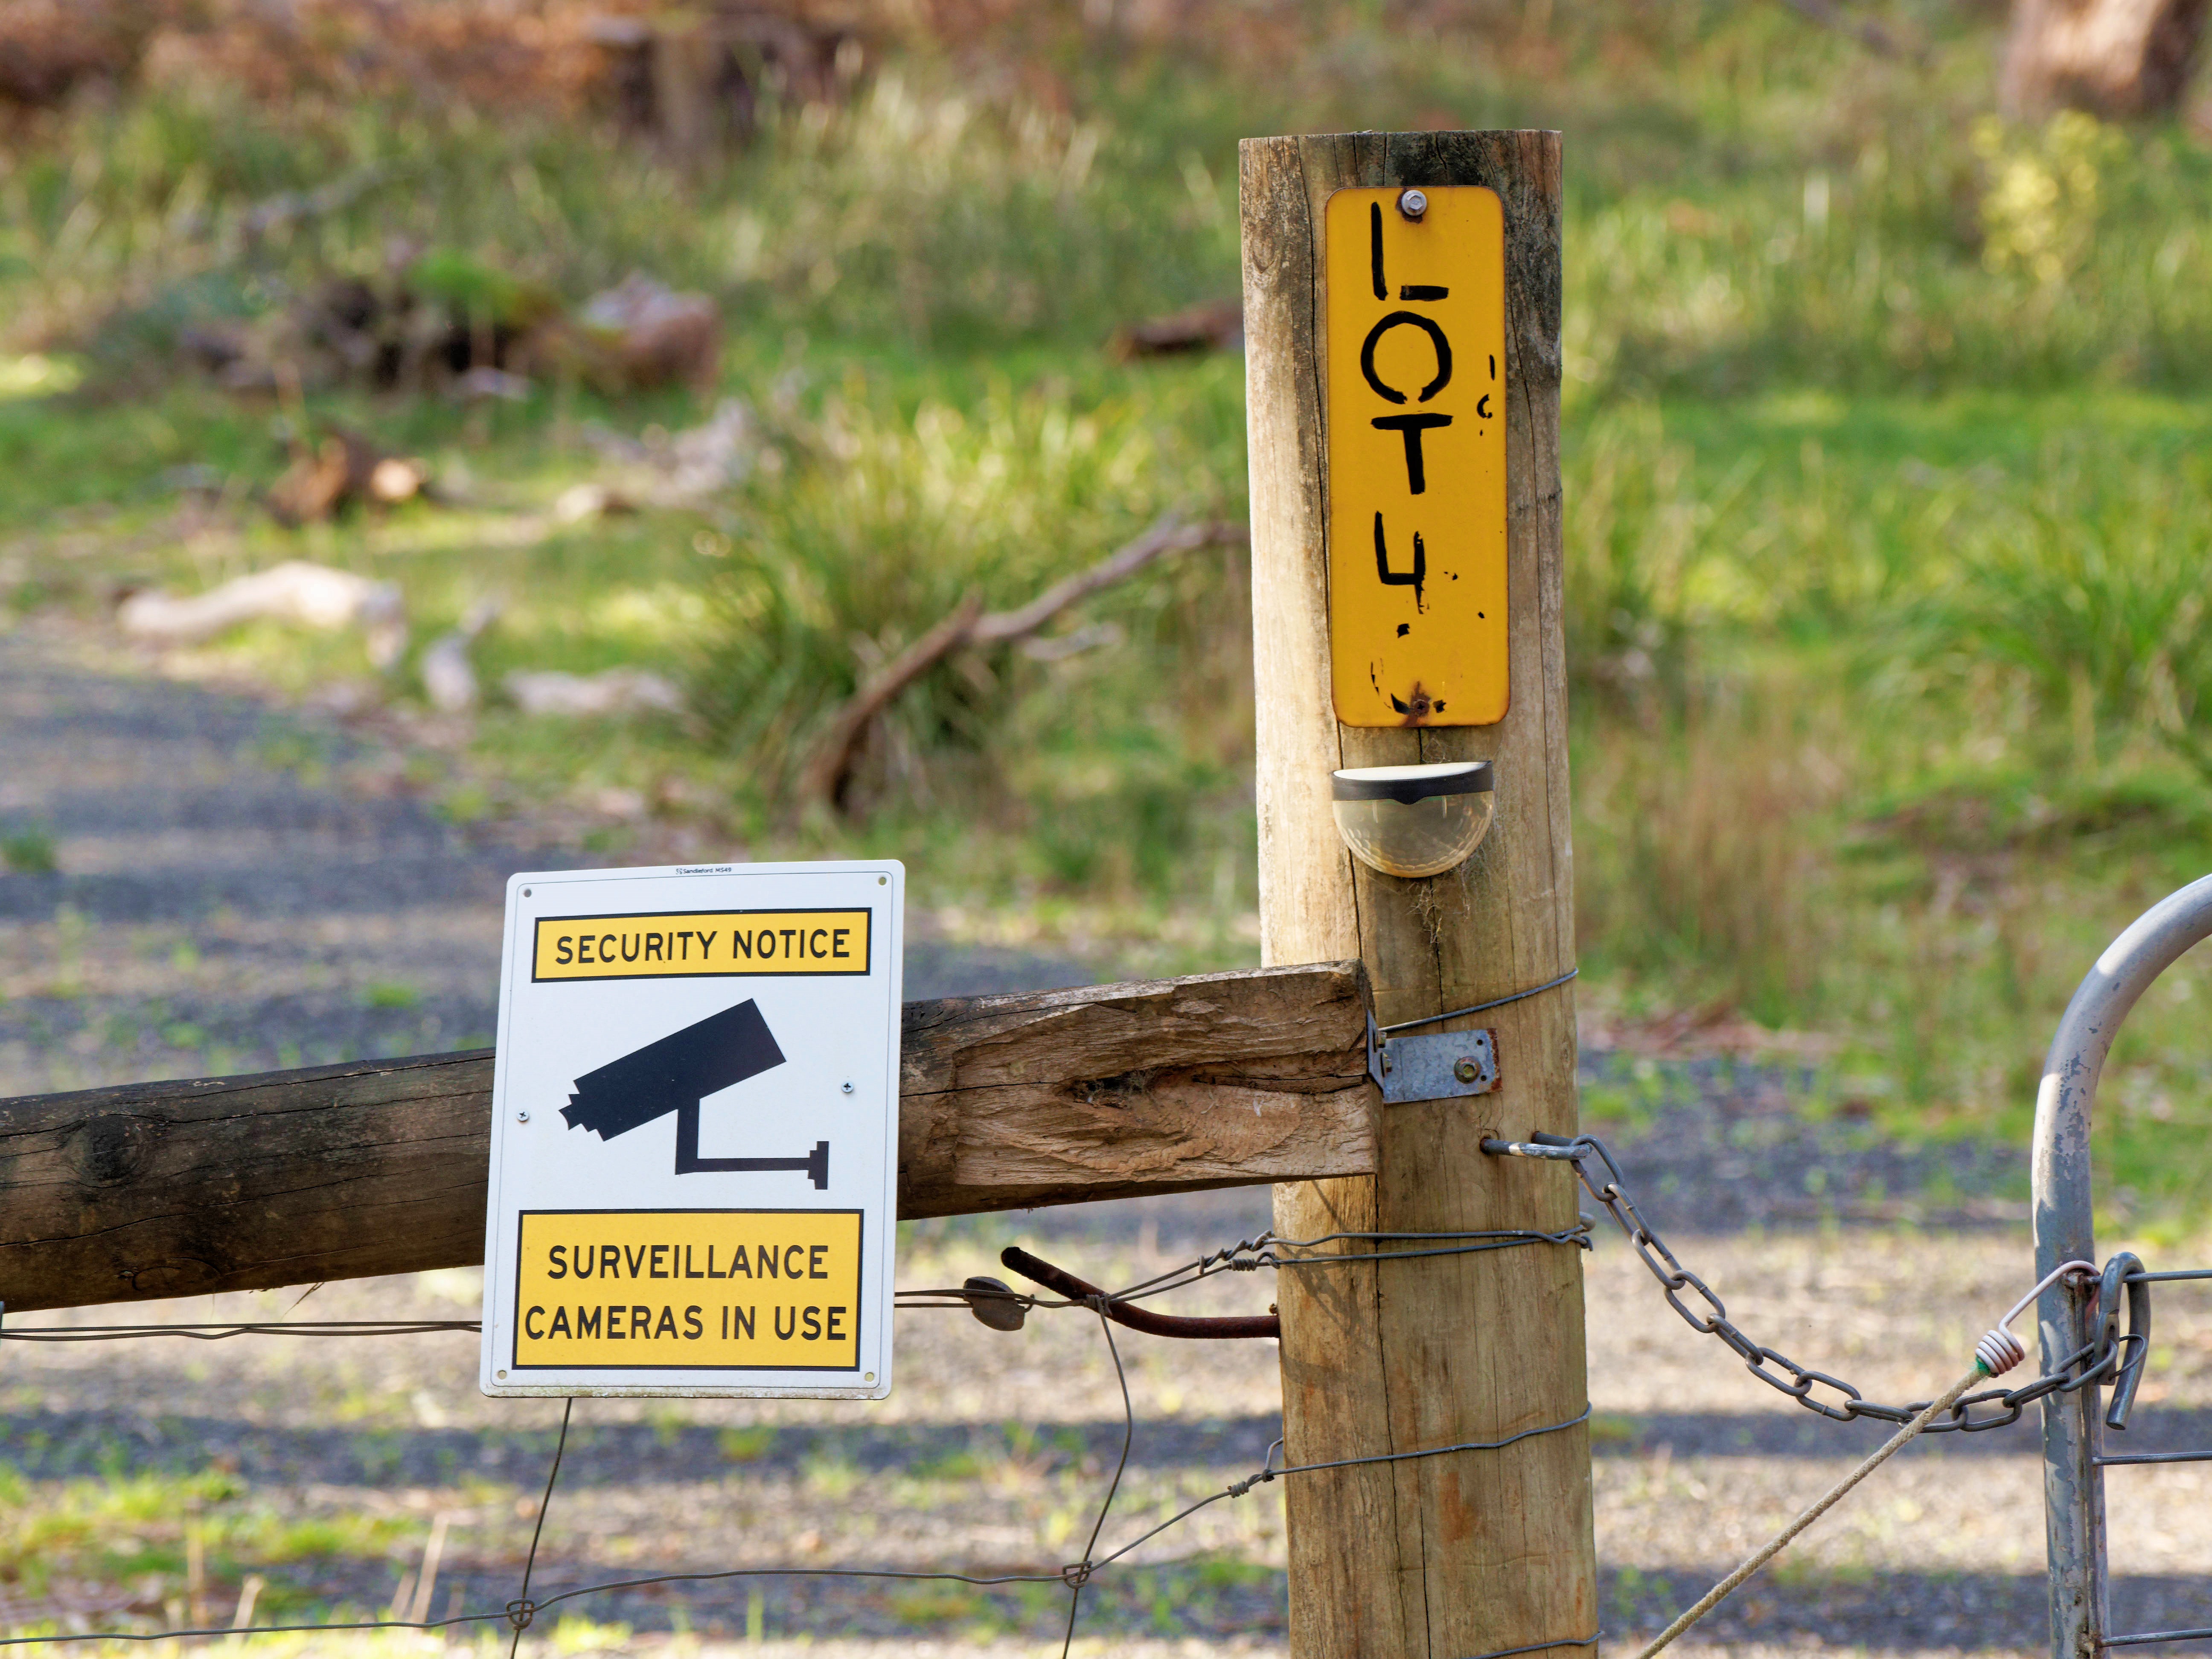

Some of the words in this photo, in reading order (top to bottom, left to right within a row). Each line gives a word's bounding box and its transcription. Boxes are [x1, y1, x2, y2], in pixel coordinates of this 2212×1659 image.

[1360, 201, 1454, 495] LOT
[1374, 511, 1425, 614] 4
[555, 931, 718, 964] SECURITY
[733, 929, 850, 959] NOTICE
[547, 1245, 829, 1279] SURVEILLANCE
[525, 1305, 704, 1340] CAMERAS
[722, 1306, 755, 1339] IN
[774, 1306, 847, 1341] USE
